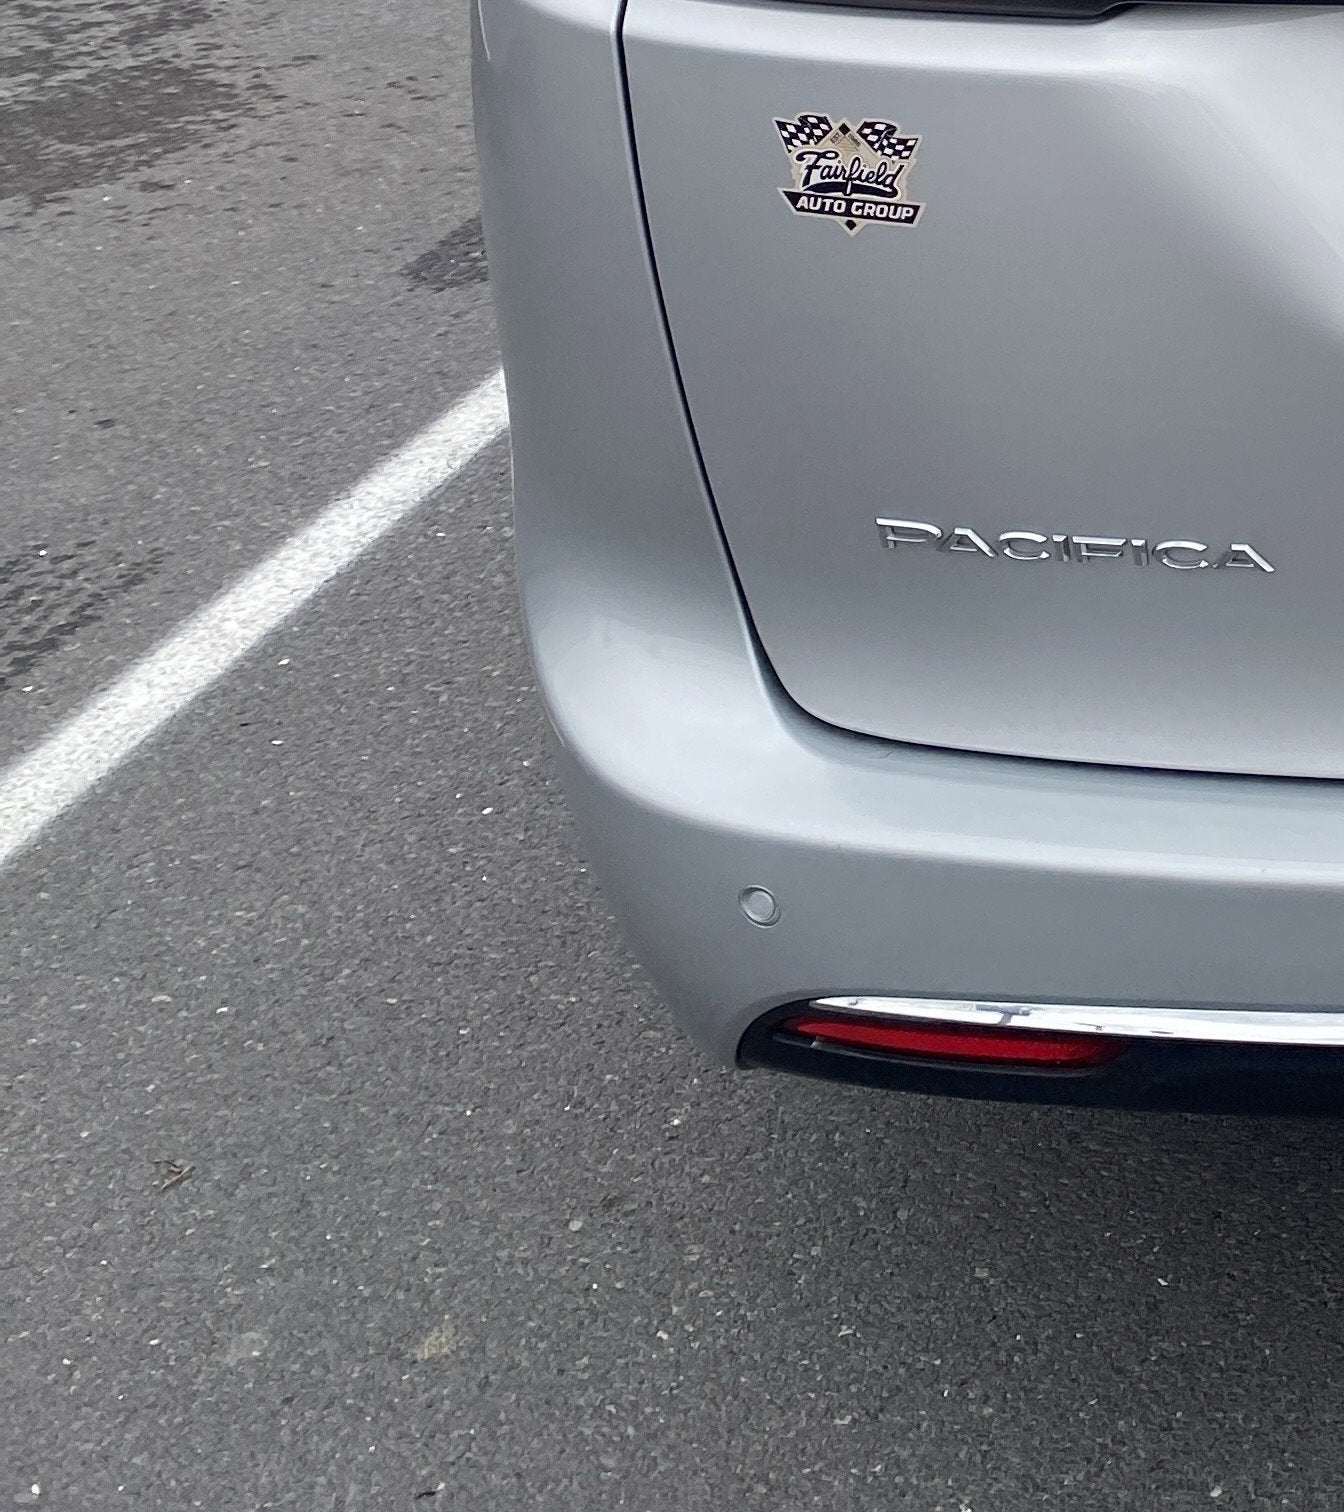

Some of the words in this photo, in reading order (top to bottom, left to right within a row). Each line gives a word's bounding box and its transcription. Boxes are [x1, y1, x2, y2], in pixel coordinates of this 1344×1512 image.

[795, 150, 905, 189] Fairfield
[796, 195, 847, 214] AUTO
[850, 201, 915, 220] GROUP
[875, 516, 1275, 574] PACIFICA
